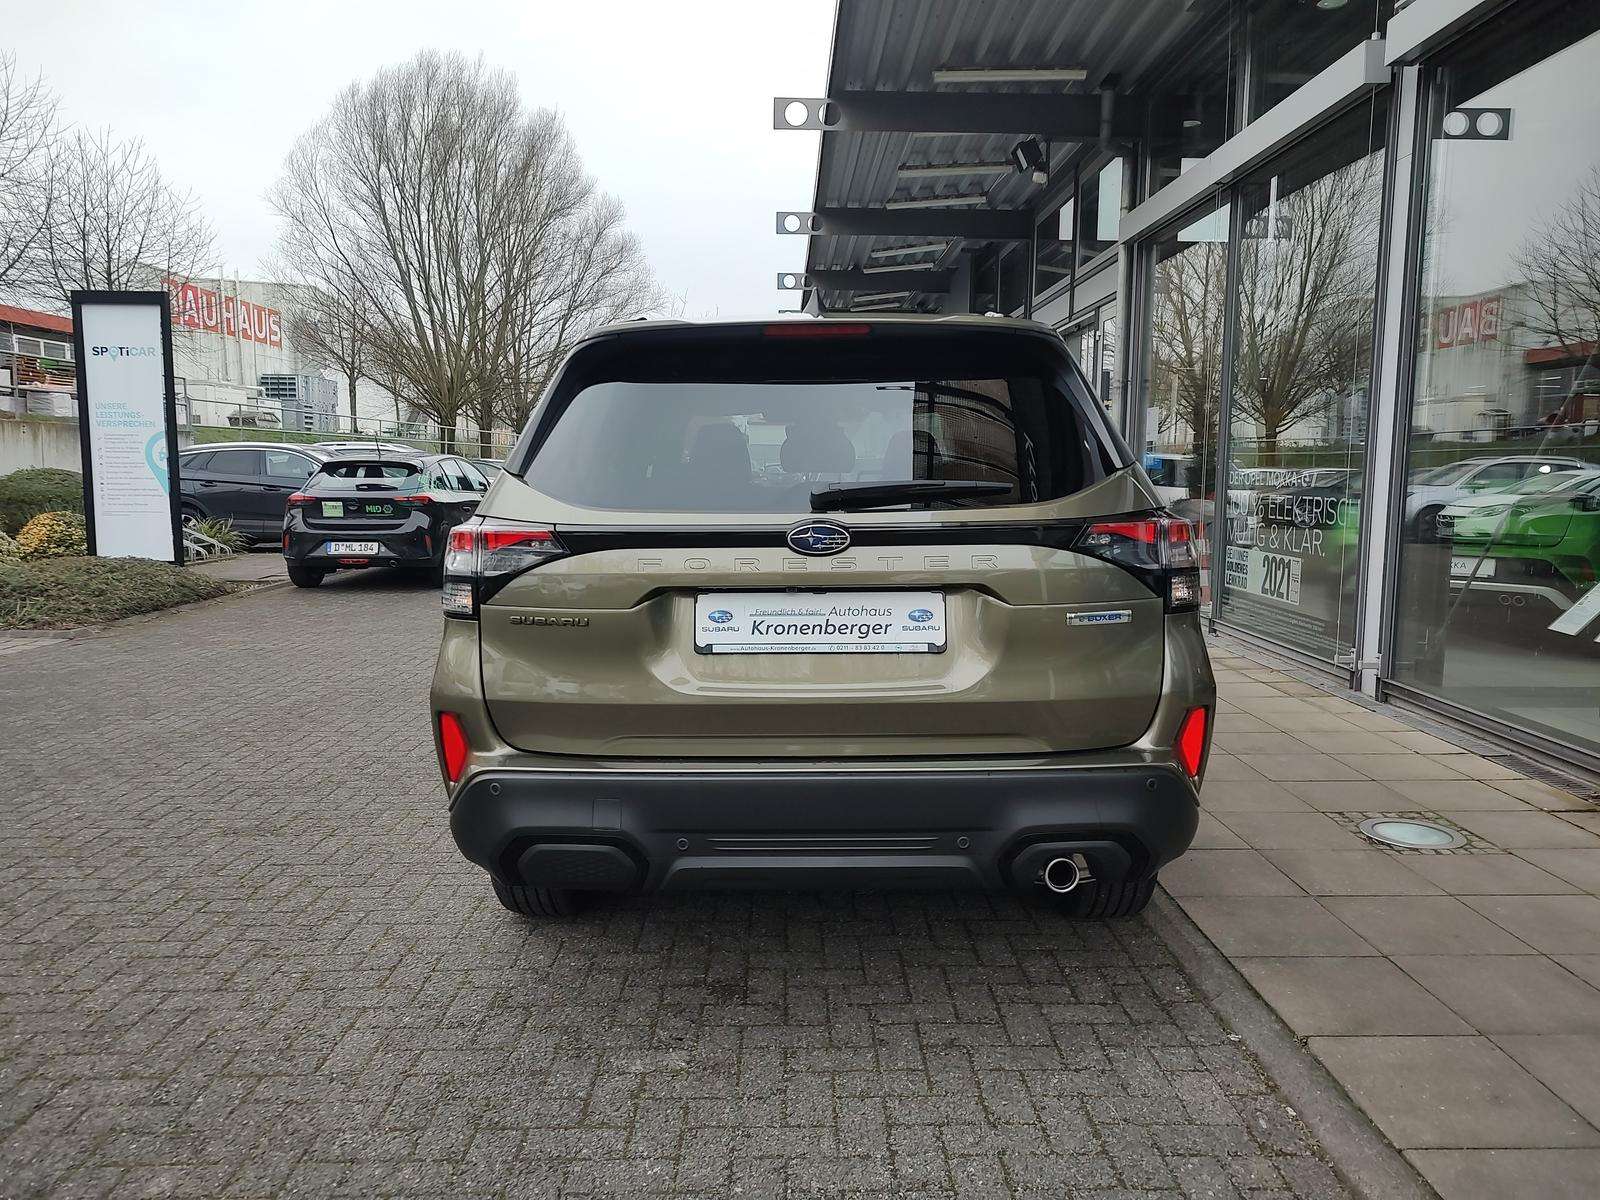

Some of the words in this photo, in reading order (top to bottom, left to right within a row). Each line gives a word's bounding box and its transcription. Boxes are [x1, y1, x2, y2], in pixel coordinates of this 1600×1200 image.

[96, 402, 128, 410] UNSERE
[96, 420, 156, 428] VERSPRECHEN
[1229, 471, 1243, 486] DER
[1269, 524, 1280, 549] &
[334, 543, 341, 552] D
[358, 543, 374, 552] 184
[637, 554, 1000, 573] FORESTER
[1261, 554, 1292, 602] 2021
[755, 608, 796, 617] Freundlich
[797, 608, 804, 617] &
[828, 605, 893, 617] Autohaus
[509, 614, 591, 628] SUBARU
[751, 618, 893, 639] Kronenberger
